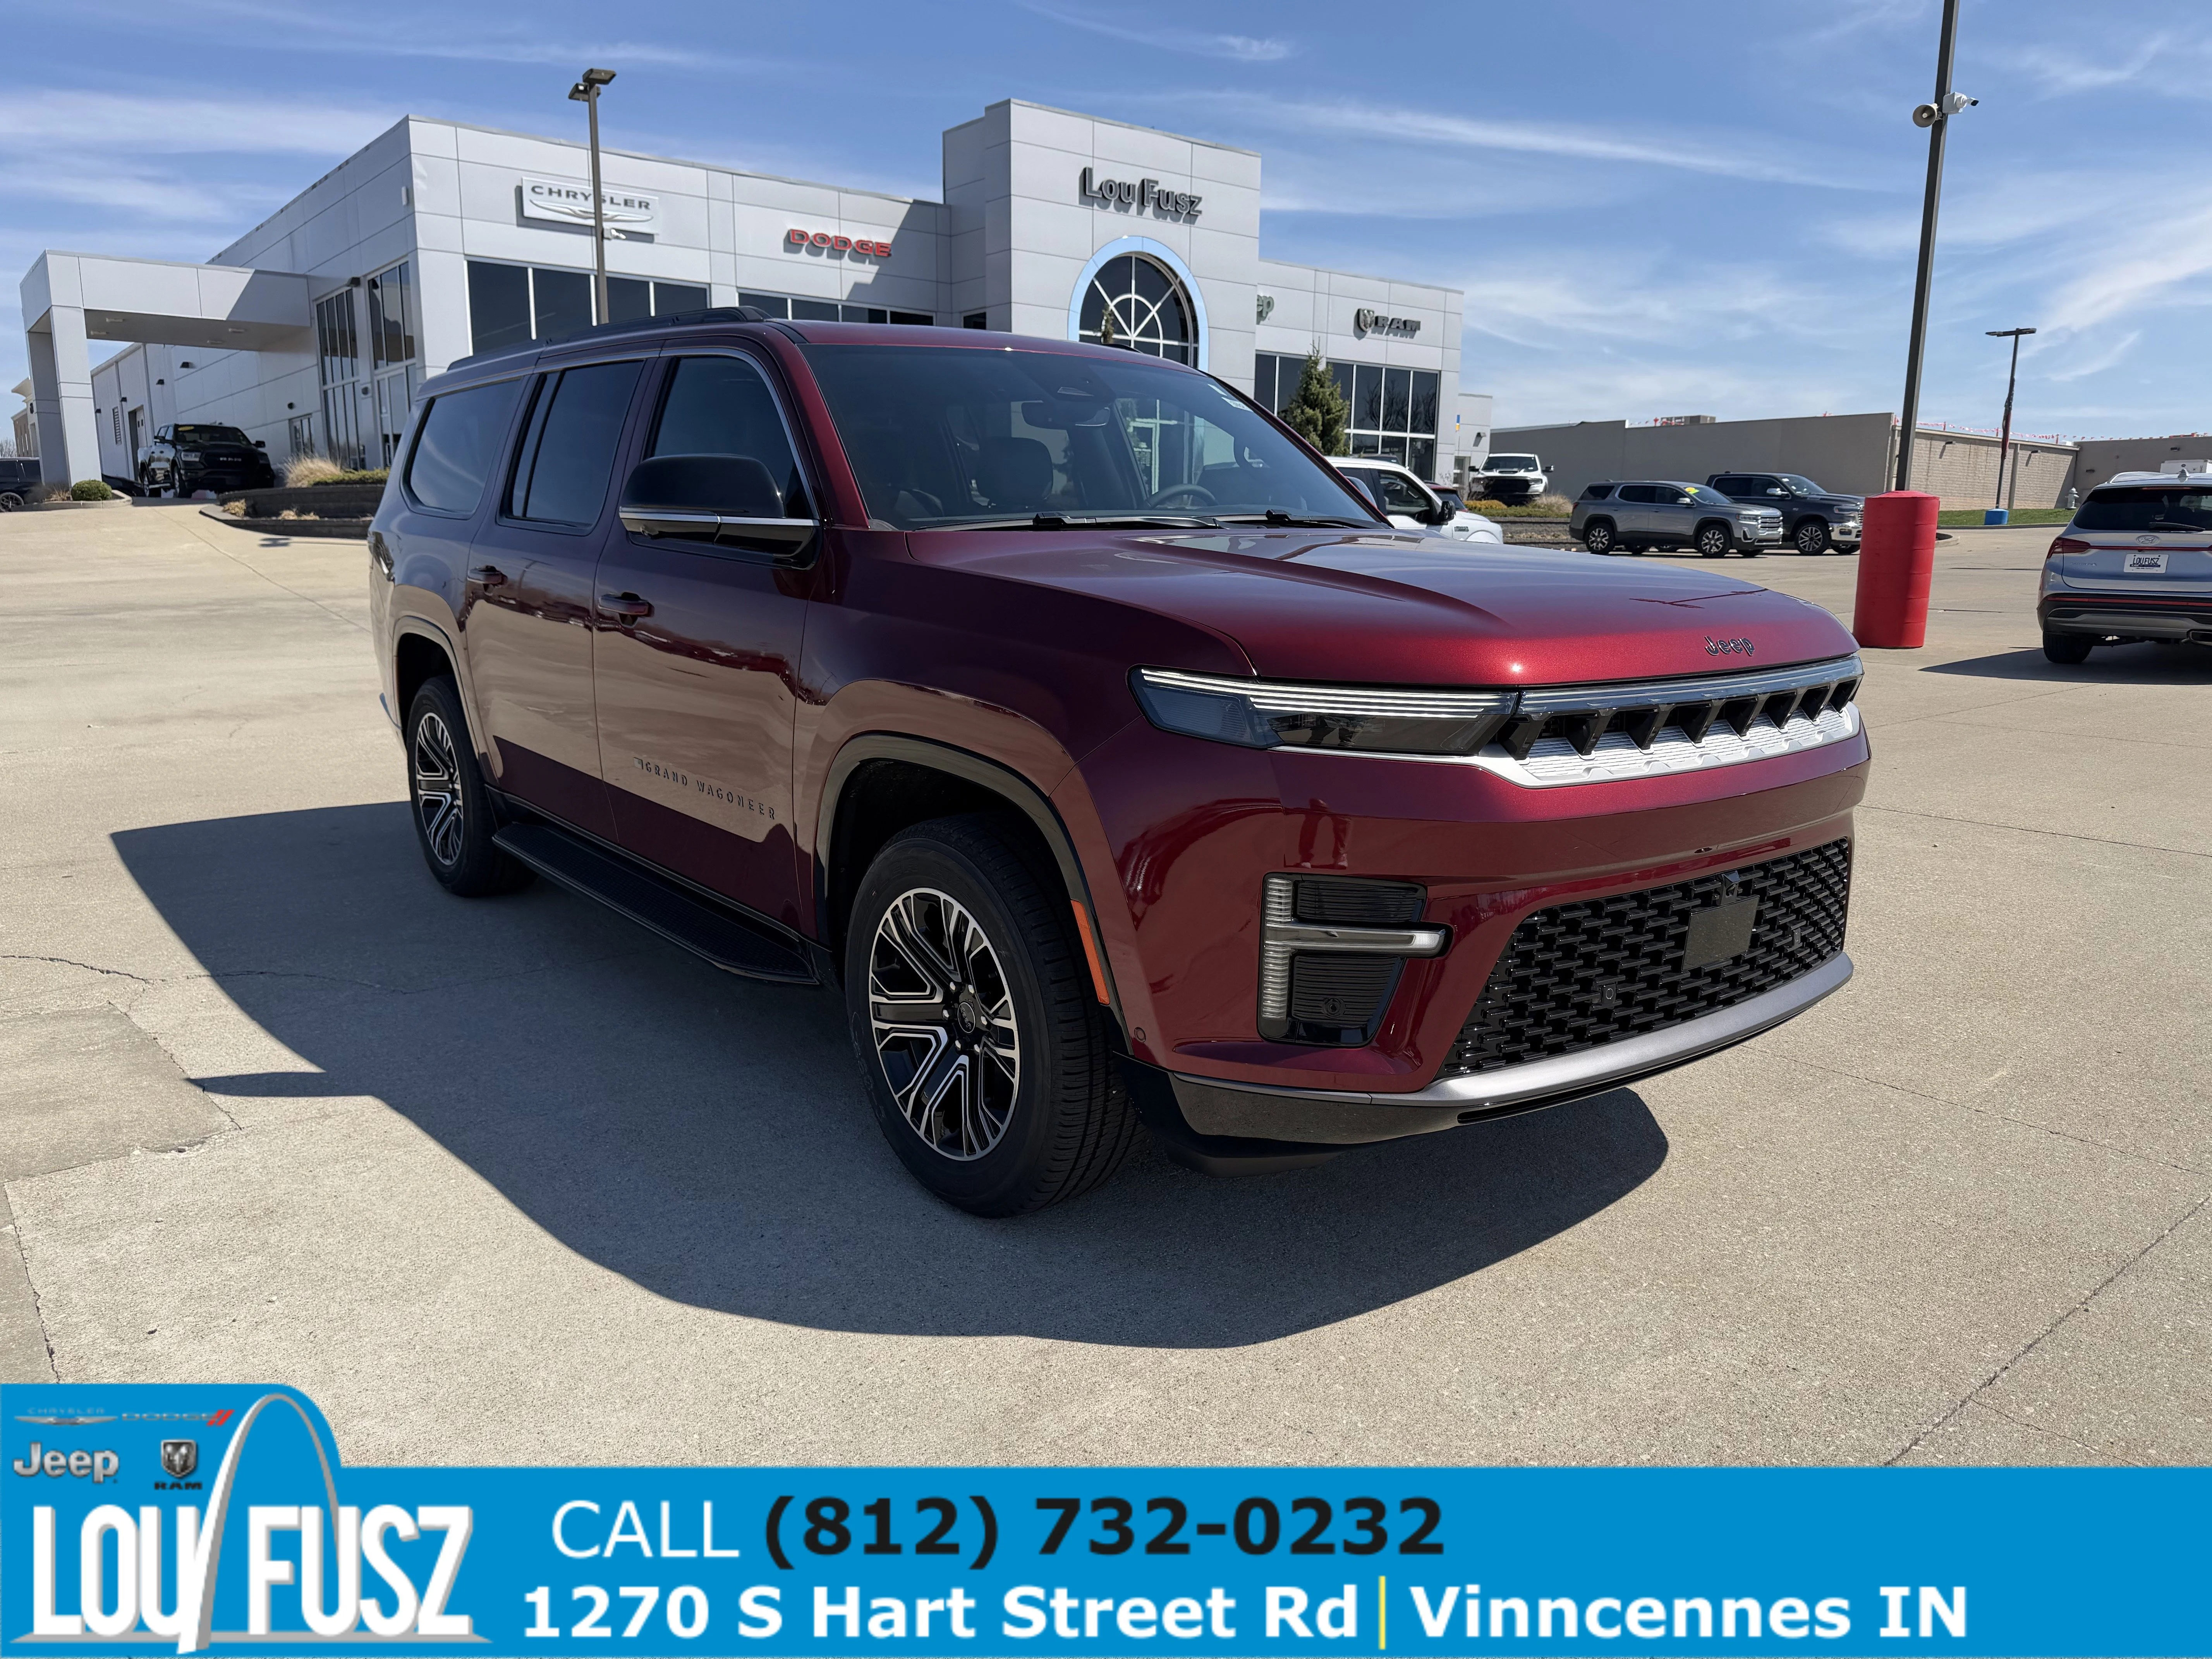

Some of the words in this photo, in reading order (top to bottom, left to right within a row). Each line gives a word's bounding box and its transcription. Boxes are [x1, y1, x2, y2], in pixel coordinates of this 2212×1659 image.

[1083, 167, 1136, 203] Lou
[1142, 179, 1202, 215] Fusz
[789, 229, 892, 257] DODGE
[1375, 316, 1421, 330] RAM
[1704, 636, 1755, 656] Jeep
[645, 761, 688, 786] GRAND
[696, 780, 775, 820] WAGONEER
